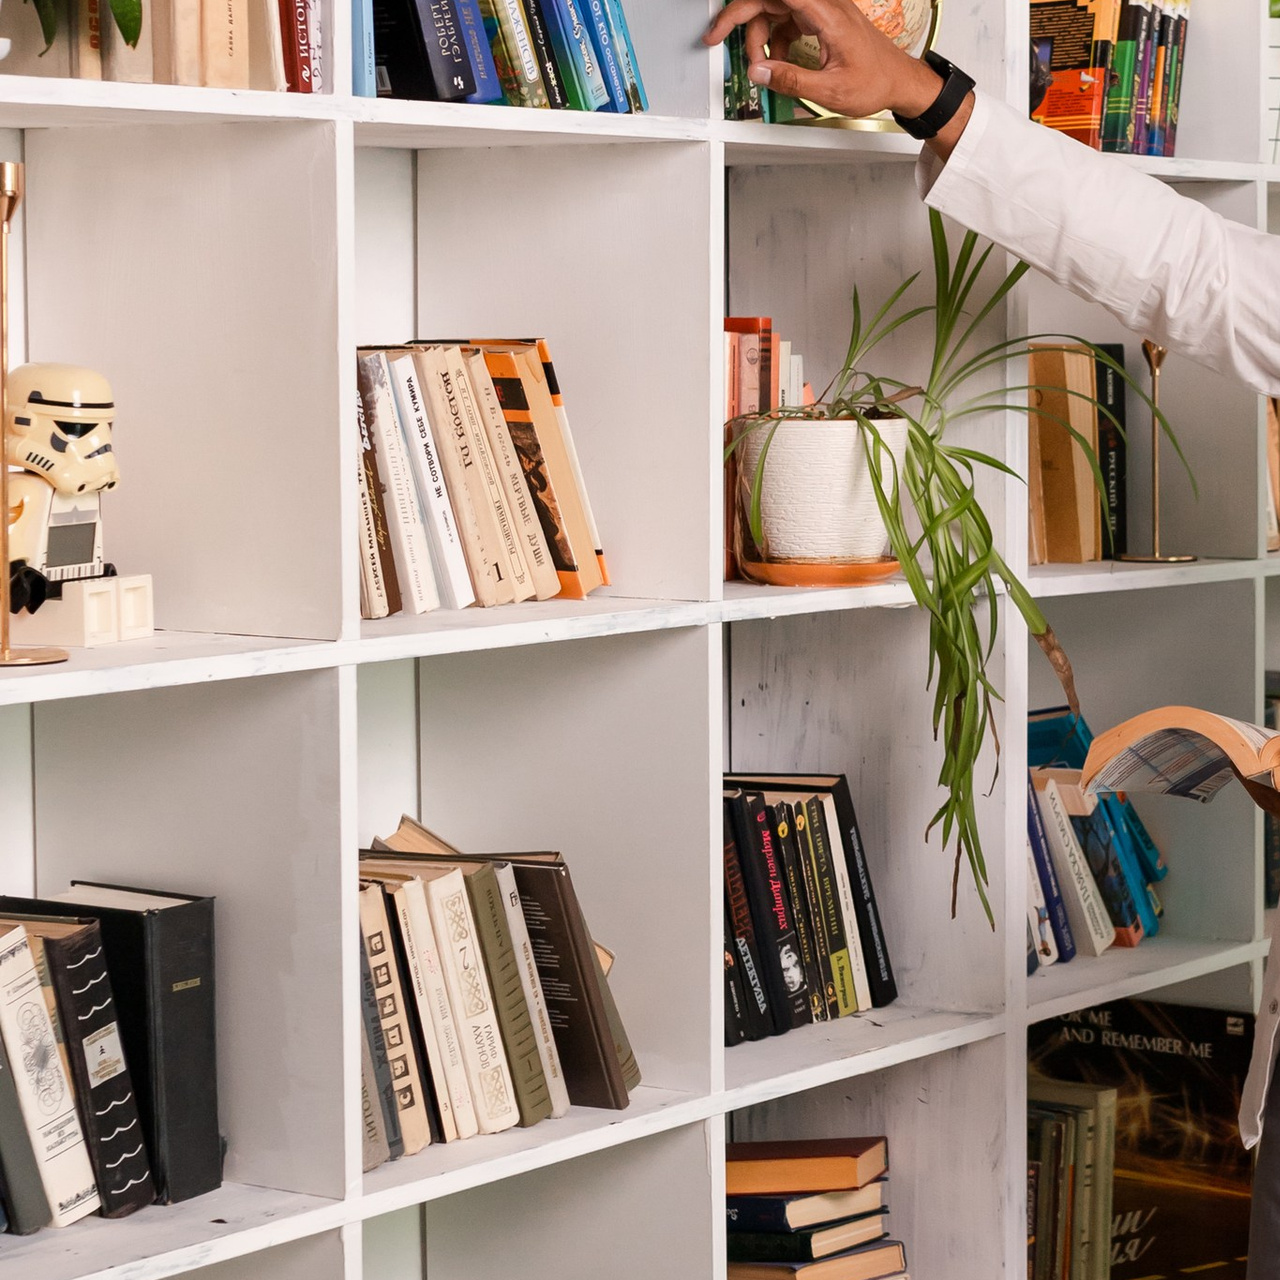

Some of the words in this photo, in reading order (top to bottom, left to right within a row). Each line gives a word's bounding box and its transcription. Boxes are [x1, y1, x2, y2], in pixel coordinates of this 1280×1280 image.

[429, 3, 451, 56] РОБЕРТ
[579, 36, 593, 77] Джек
[598, 21, 609, 45] КТО
[605, 47, 625, 104] останется
[406, 375, 423, 413] КУМИРА
[415, 415, 427, 441] СЕБЕ
[423, 441, 443, 484] СОТВОРИ
[1109, 450, 1117, 510] РУССКИЙ
[436, 484, 444, 499] НЕ
[494, 499, 515, 556] ГИМНАЗИСТЫ
[509, 473, 533, 527] МЕРТВЫЕ
[527, 532, 544, 567] ДУШИ
[810, 804, 821, 834] ТРИ
[815, 836, 830, 874] ЦВЕТА
[762, 830, 778, 880] Марлен
[771, 879, 789, 930] Дитрих
[1068, 848, 1090, 905] ПЛЯСКА
[823, 875, 839, 936] ВРЕМЕНИ
[458, 945, 470, 971] 2
[1088, 1009, 1112, 1028] ME
[471, 1024, 491, 1070] АХУНОВ
[483, 1023, 499, 1060] ГАРИФ
[1060, 1027, 1095, 1044] AND
[1101, 1030, 1183, 1055] REMEMBER
[1188, 1041, 1213, 1059] ME
